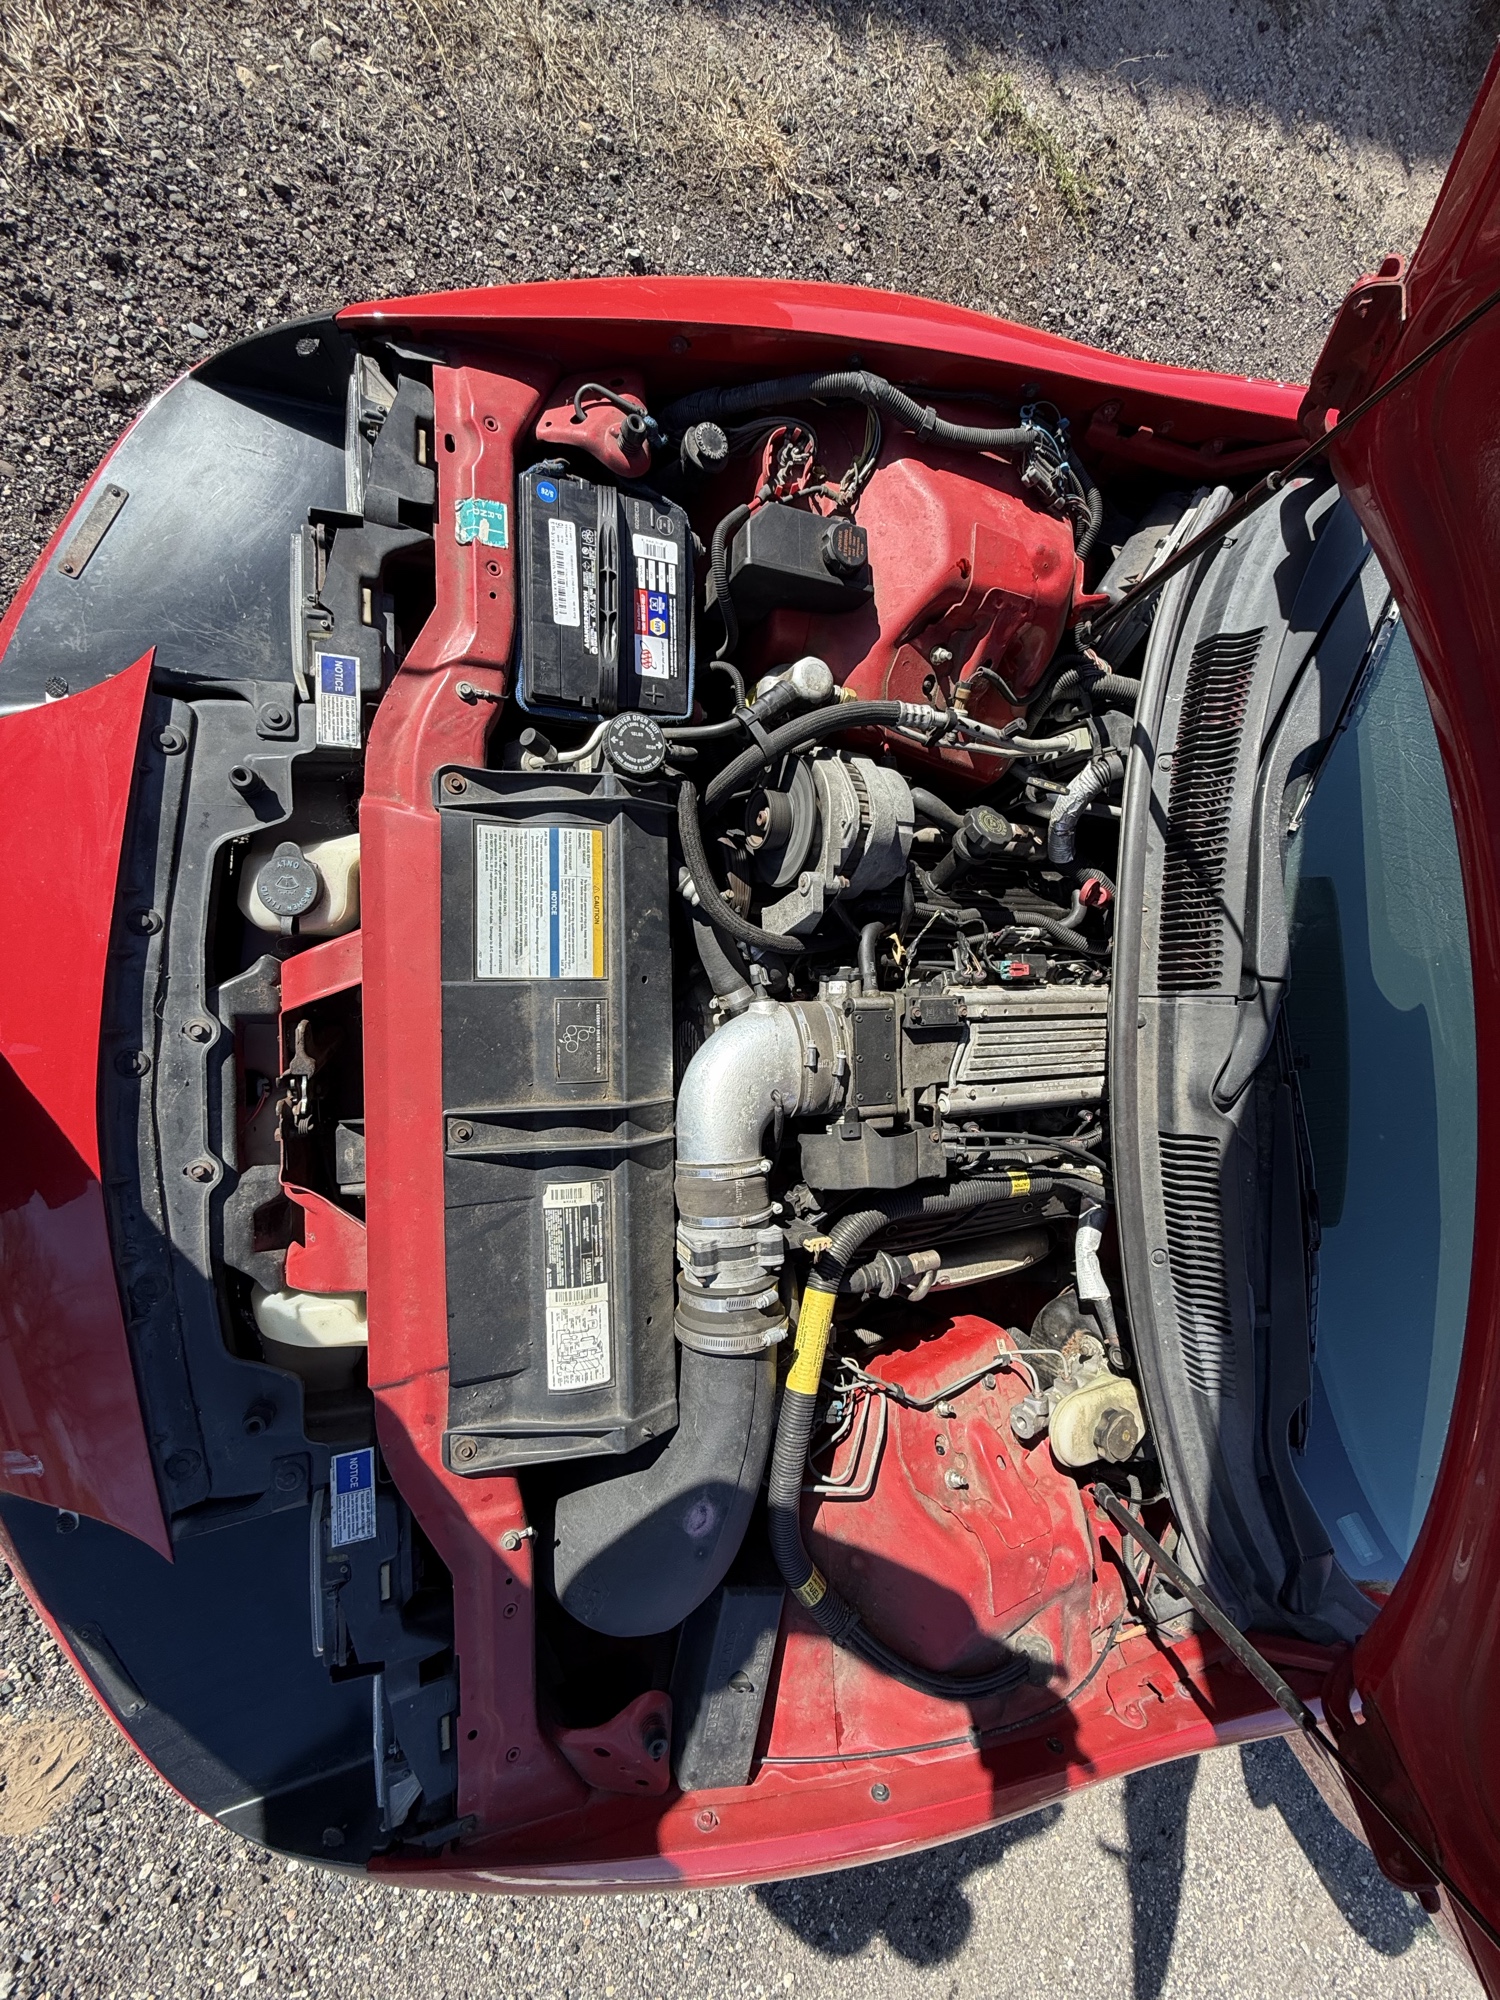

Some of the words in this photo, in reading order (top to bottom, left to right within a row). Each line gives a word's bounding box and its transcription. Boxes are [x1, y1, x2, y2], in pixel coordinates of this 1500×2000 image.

[641, 650, 650, 668] AAA
[334, 660, 344, 692] NOTICE
[614, 715, 631, 730] NEVER
[632, 715, 649, 724] OPEN
[648, 722, 660, 735] HOT
[645, 726, 656, 741] BOTTLE
[277, 859, 300, 870] ONLY
[260, 886, 282, 910] FLUID
[287, 886, 313, 911] WASHER
[349, 1456, 359, 1489] NOTICE
[806, 1582, 820, 1600] FUEL
[703, 1694, 724, 1738] FUSES
